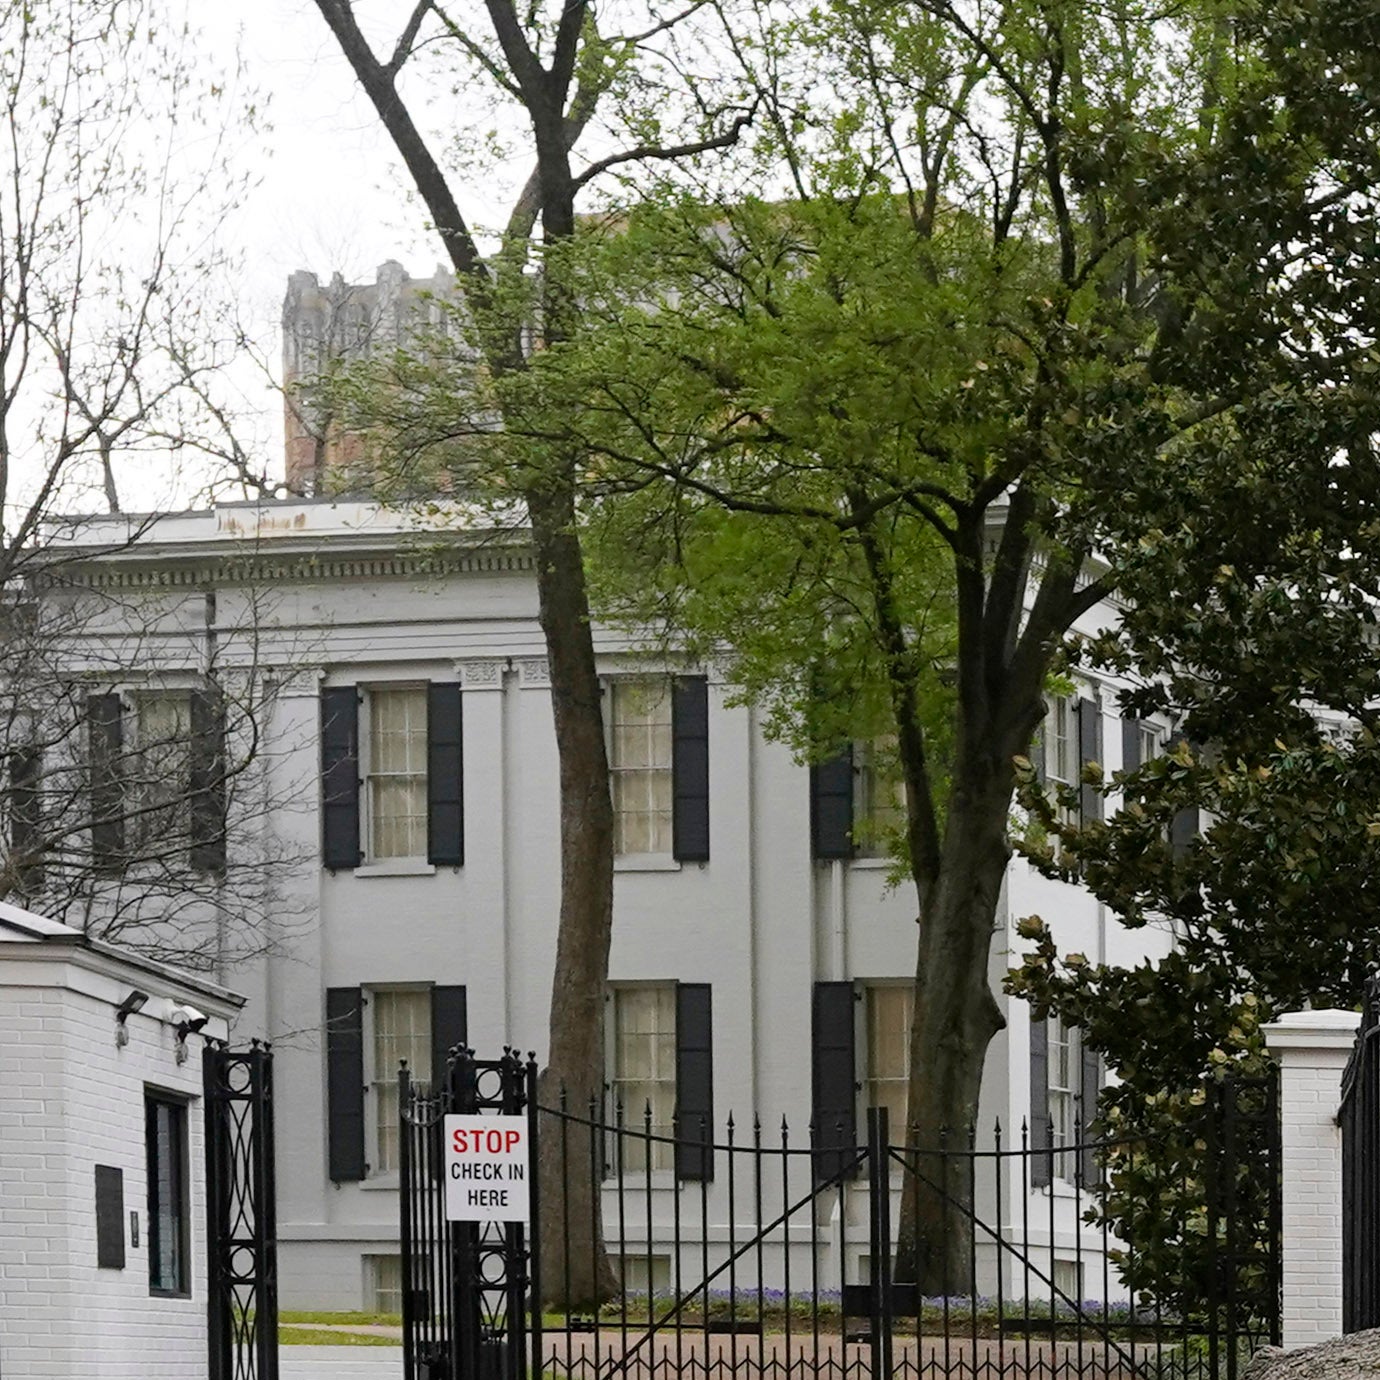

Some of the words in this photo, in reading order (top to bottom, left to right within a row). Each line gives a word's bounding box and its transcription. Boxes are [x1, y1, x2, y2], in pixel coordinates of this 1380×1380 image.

[453, 1129, 520, 1153] STOP
[451, 1162, 503, 1180] CHECK
[508, 1163, 524, 1180] IN
[468, 1189, 508, 1206] HERE
